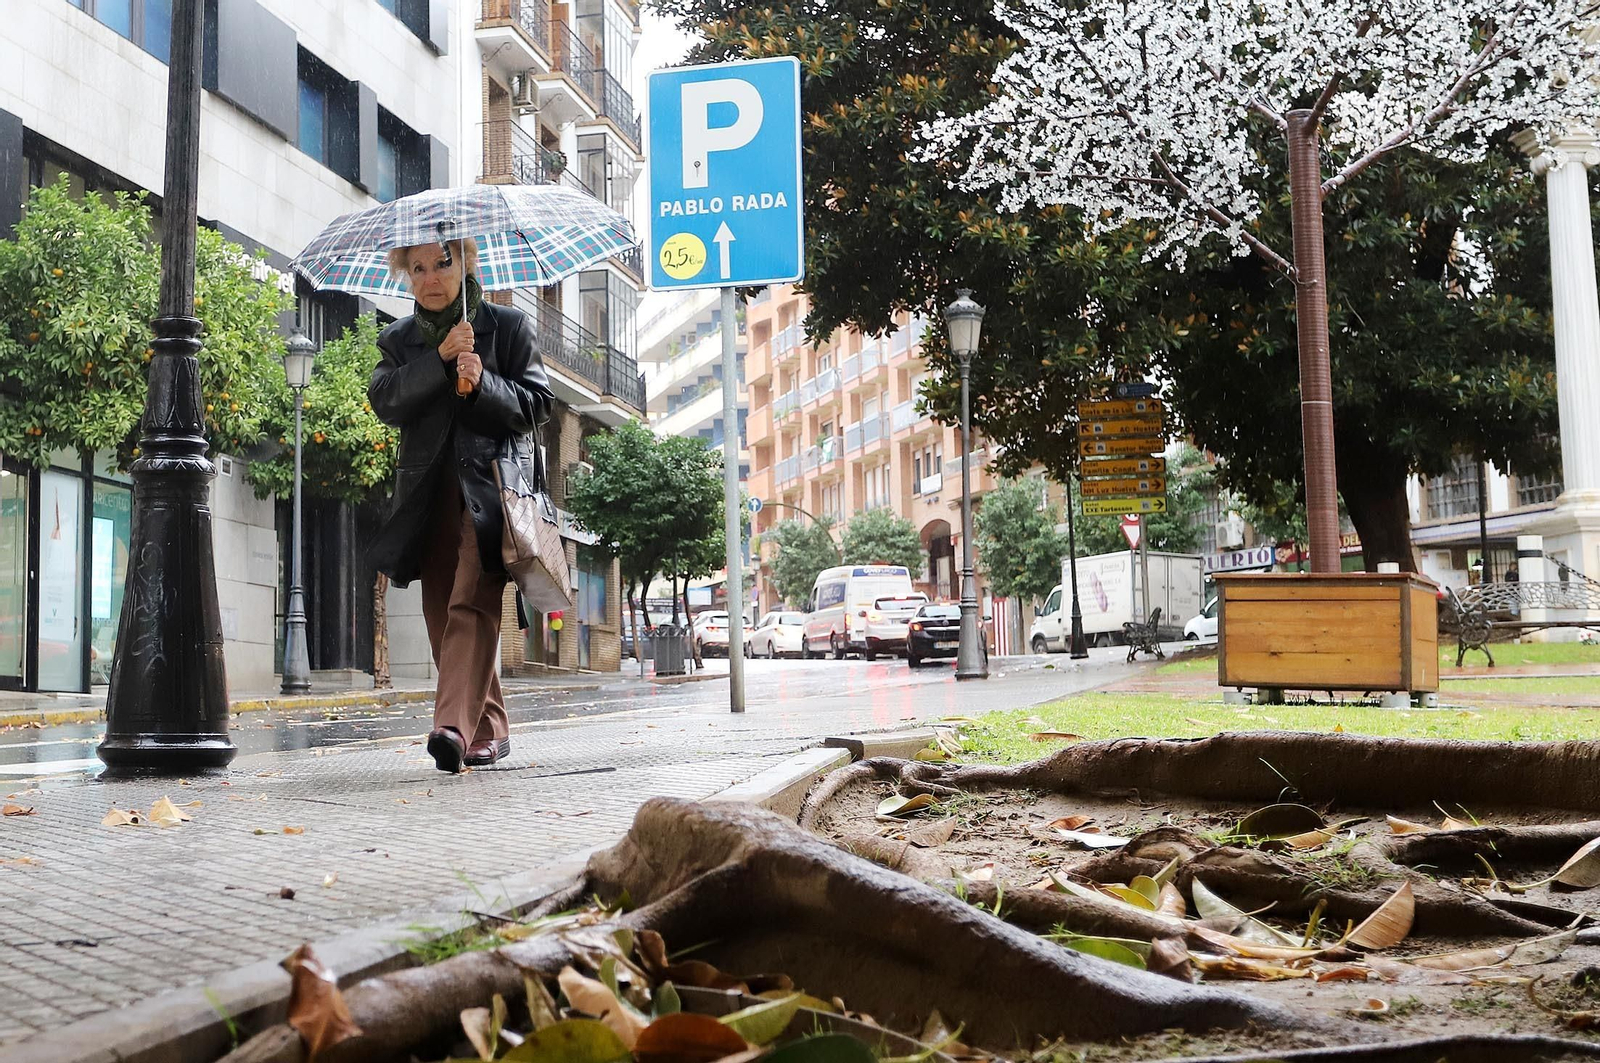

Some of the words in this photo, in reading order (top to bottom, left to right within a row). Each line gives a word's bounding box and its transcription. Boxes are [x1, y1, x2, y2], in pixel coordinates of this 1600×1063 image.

[681, 78, 765, 190] P
[660, 197, 724, 217] PABLO
[732, 192, 788, 212] RADA
